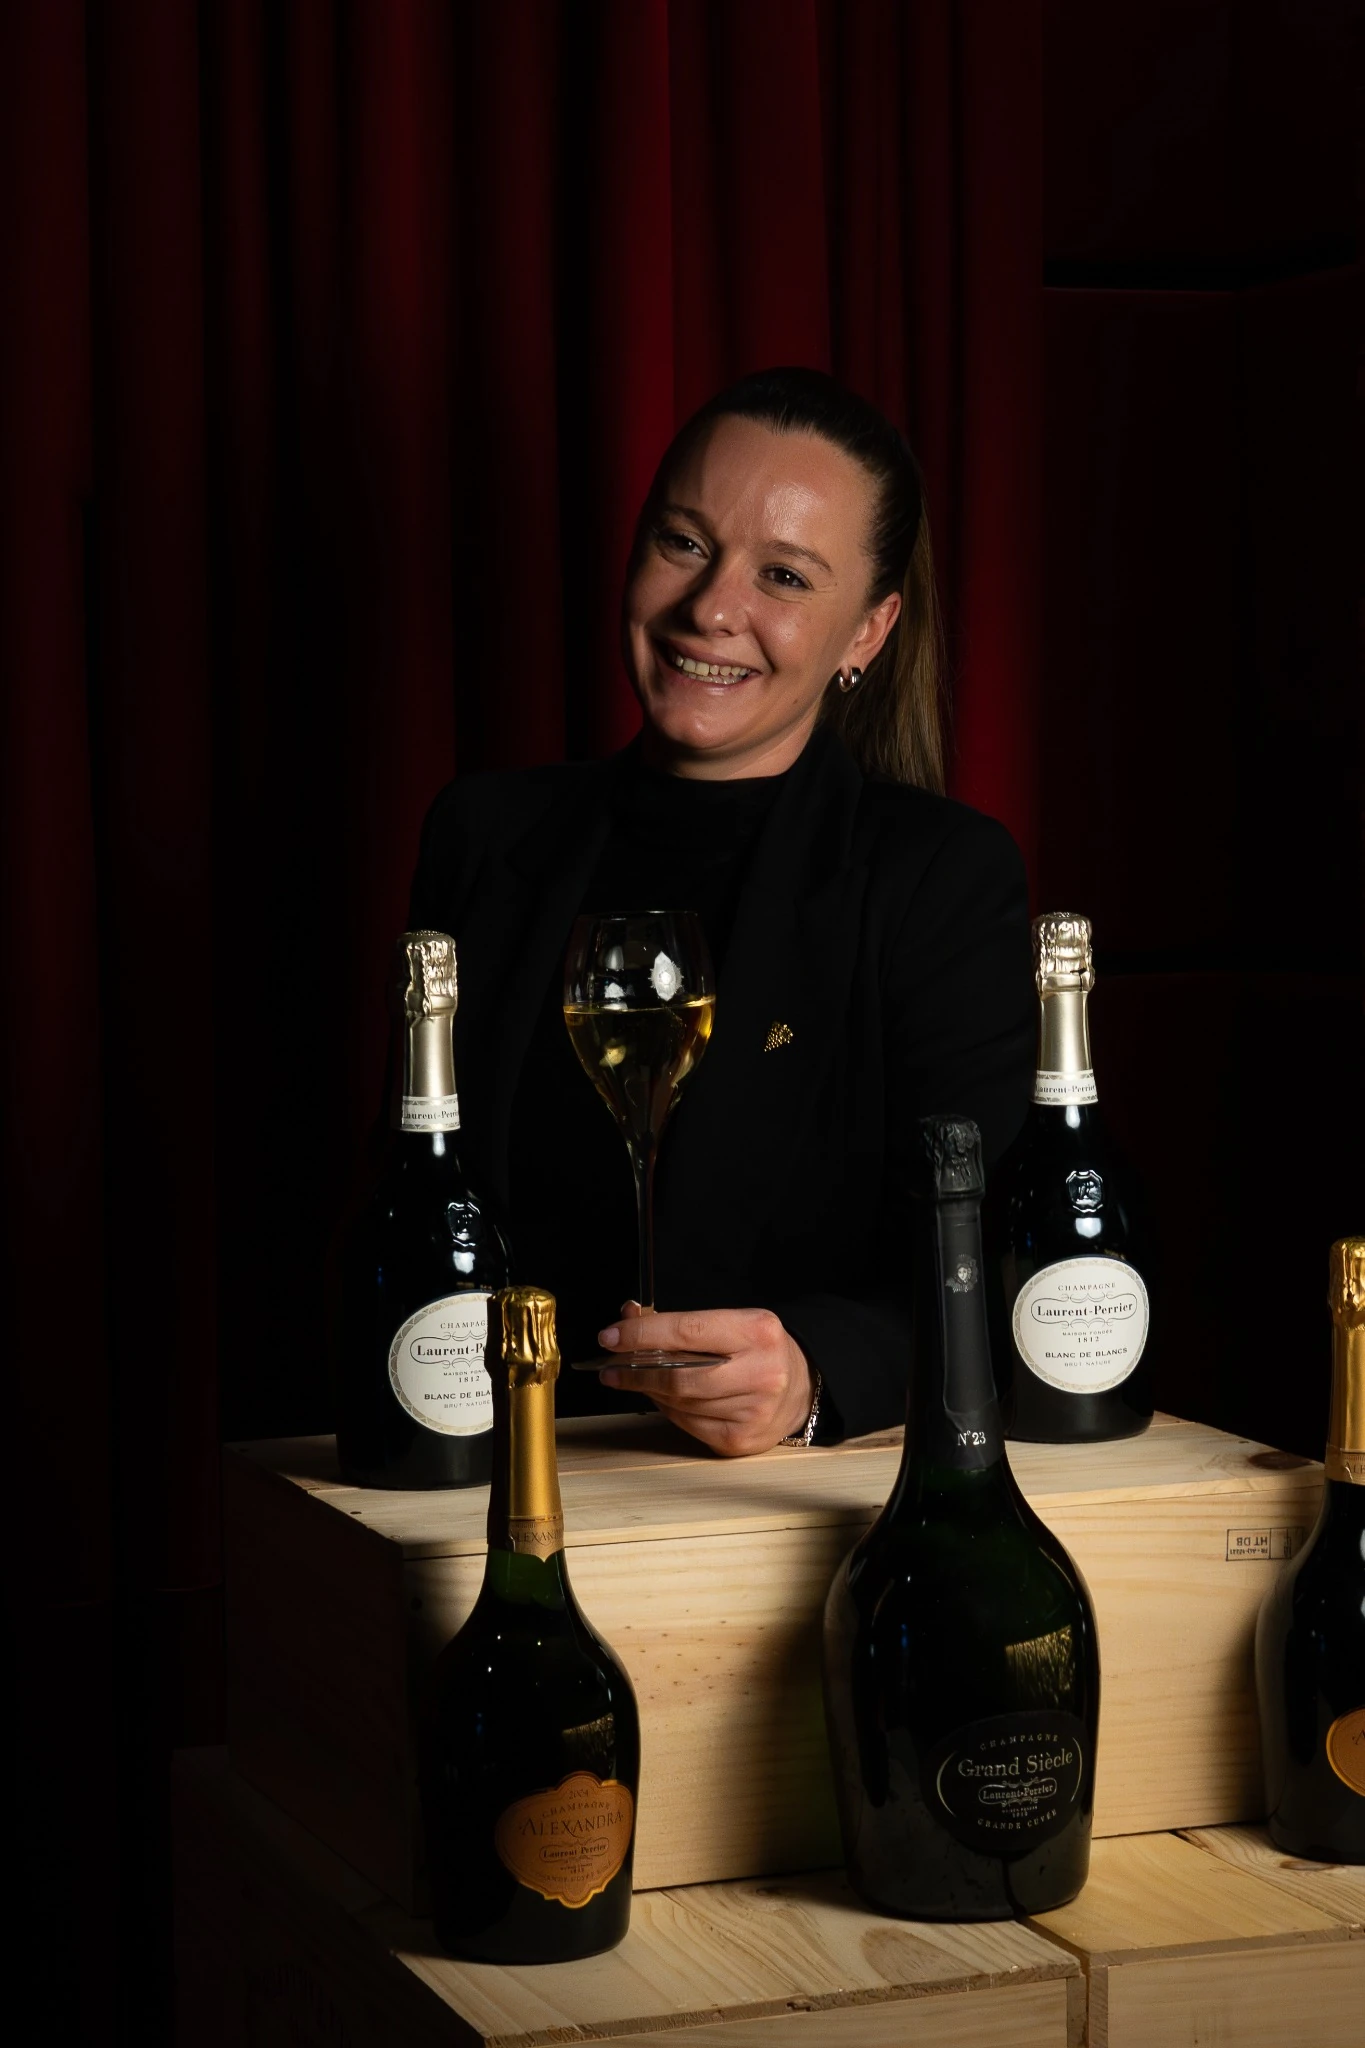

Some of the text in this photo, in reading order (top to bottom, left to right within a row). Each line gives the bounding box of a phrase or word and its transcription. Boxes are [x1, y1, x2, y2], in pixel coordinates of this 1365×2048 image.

[1058, 1282, 1116, 1291] CHAMPAGNE
[1037, 1302, 1133, 1316] Laurent-Perrier
[440, 1320, 488, 1329] CHAMPAG
[1095, 1347, 1128, 1357] BLANCS
[458, 1375, 480, 1383] 1812
[1236, 1536, 1268, 1546] HT DB
[979, 1733, 1059, 1751] CHAMPAGNE
[957, 1747, 1073, 1777] Grand Siècle
[982, 1784, 1053, 1799] Laurent-Perrier
[542, 1801, 610, 1818] CHAMPAGNE
[521, 1809, 622, 1838] ALEXANDRA
[977, 1818, 1021, 1829] GRANDE
